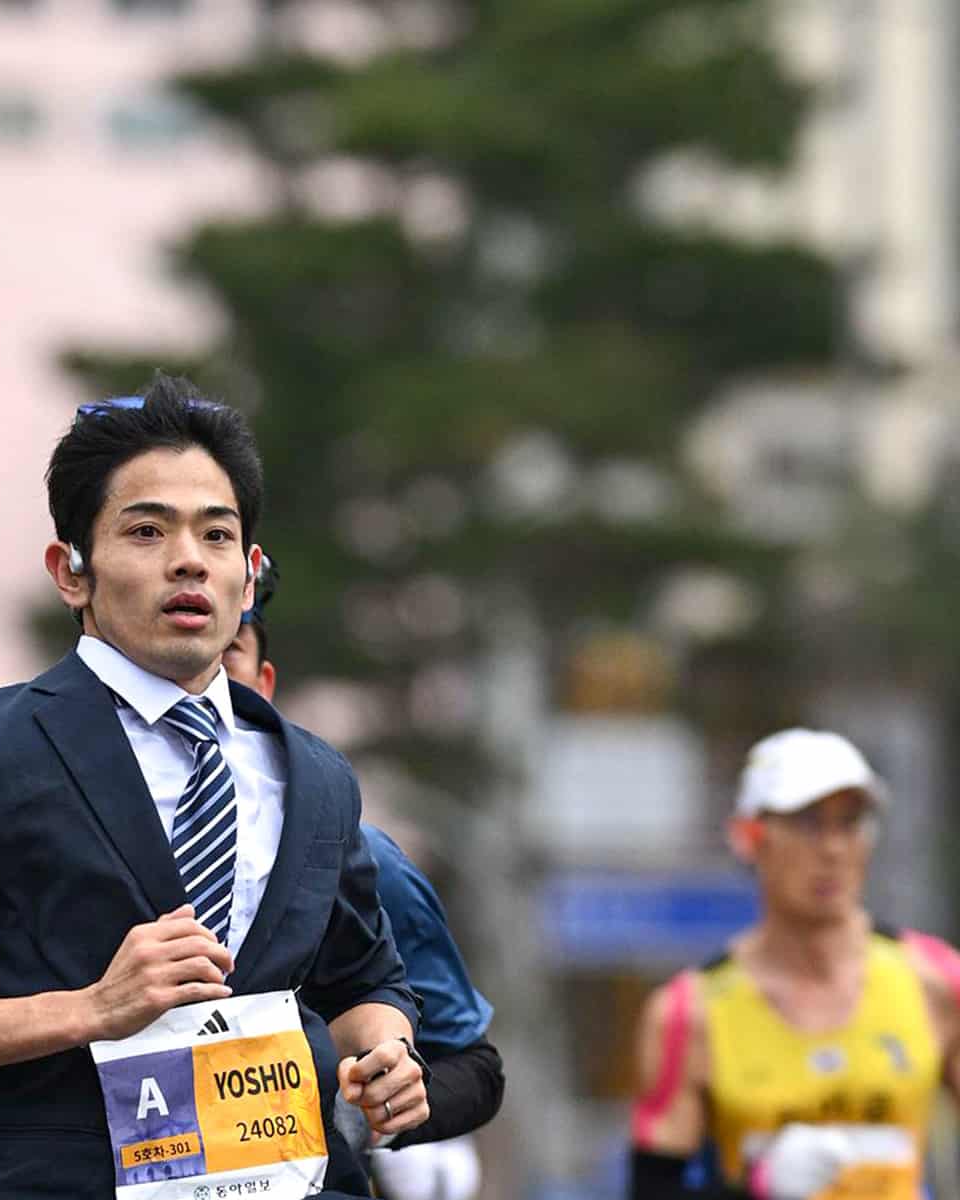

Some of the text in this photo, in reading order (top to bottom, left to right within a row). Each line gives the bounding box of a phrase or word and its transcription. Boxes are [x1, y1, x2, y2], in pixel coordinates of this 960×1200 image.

[214, 1060, 301, 1100] YOSHIO
[136, 1077, 169, 1120] A
[236, 1114, 298, 1142] 24082
[216, 1179, 271, 1199] 동아일보
